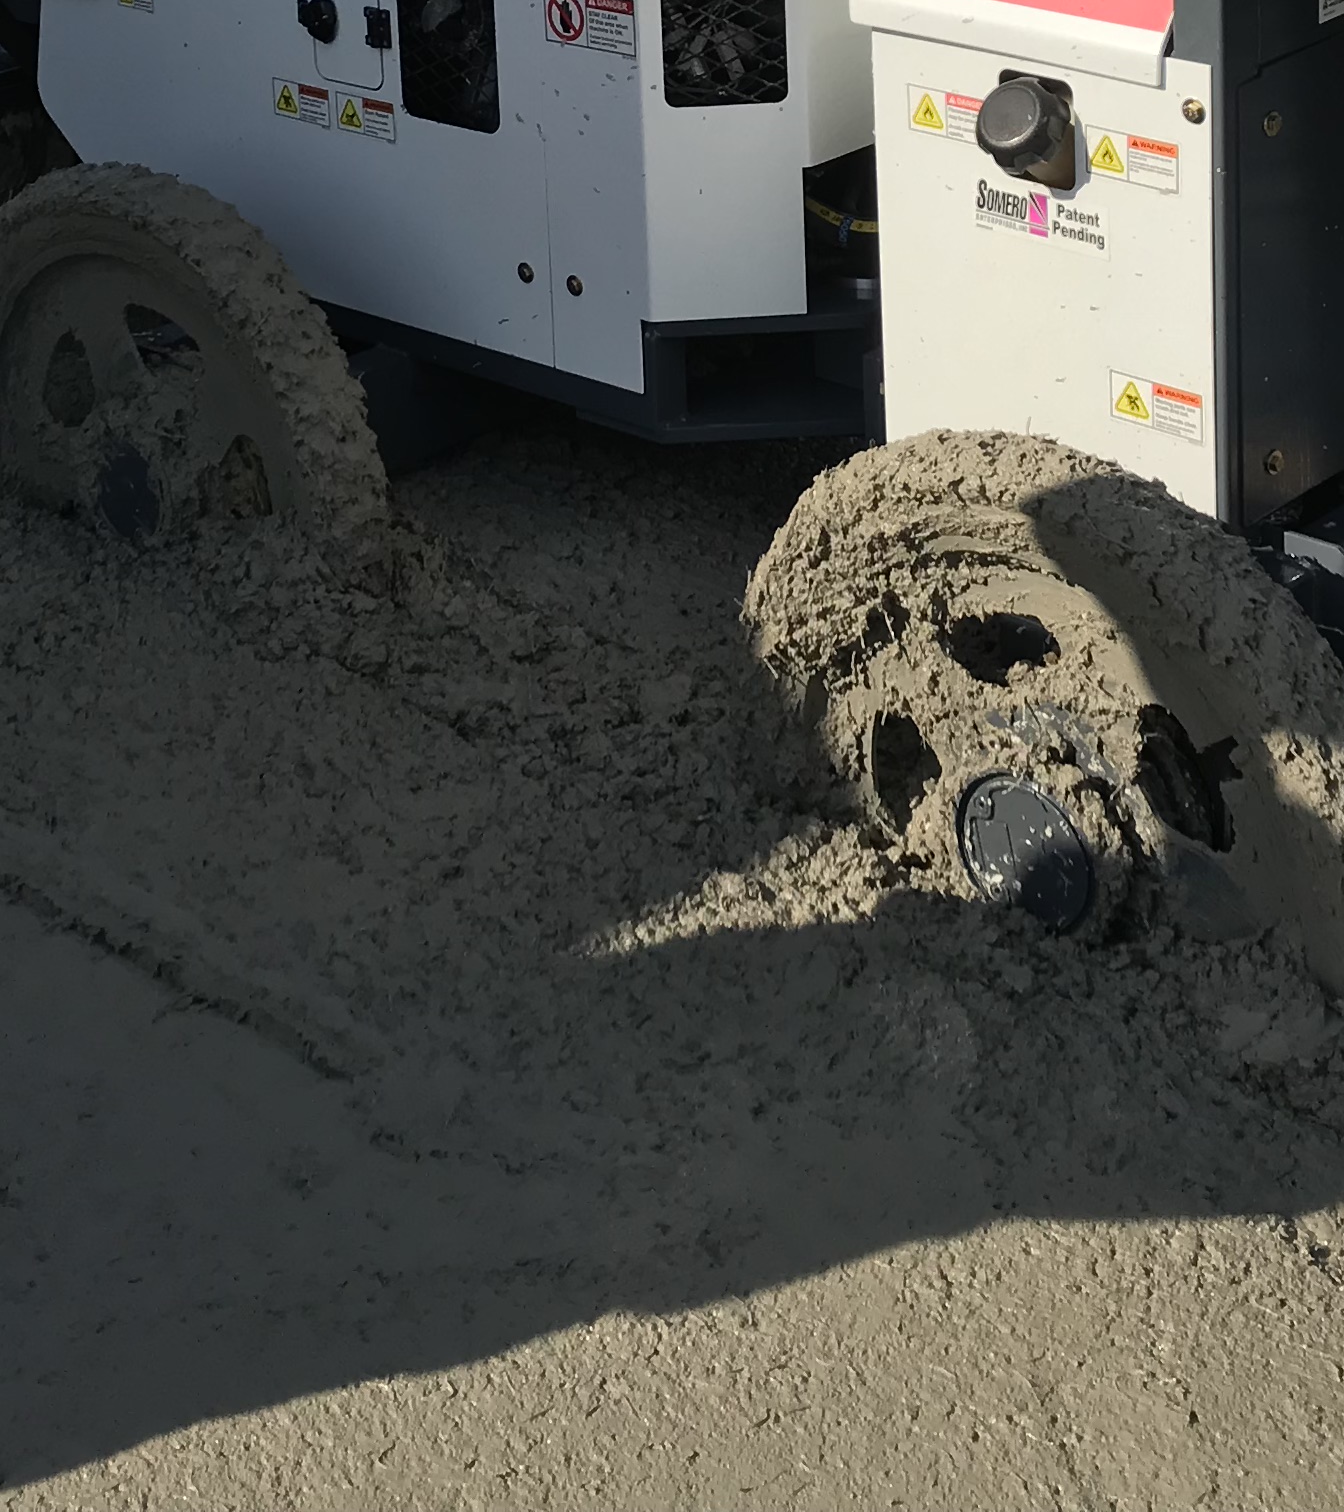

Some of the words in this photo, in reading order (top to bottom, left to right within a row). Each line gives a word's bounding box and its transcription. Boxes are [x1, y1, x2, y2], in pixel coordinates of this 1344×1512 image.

[1140, 141, 1175, 155] WARNING
[976, 178, 1028, 220] SOMERO
[1056, 203, 1100, 228] Patent
[1052, 220, 1105, 251] Pending
[1165, 389, 1200, 404] WARNING
